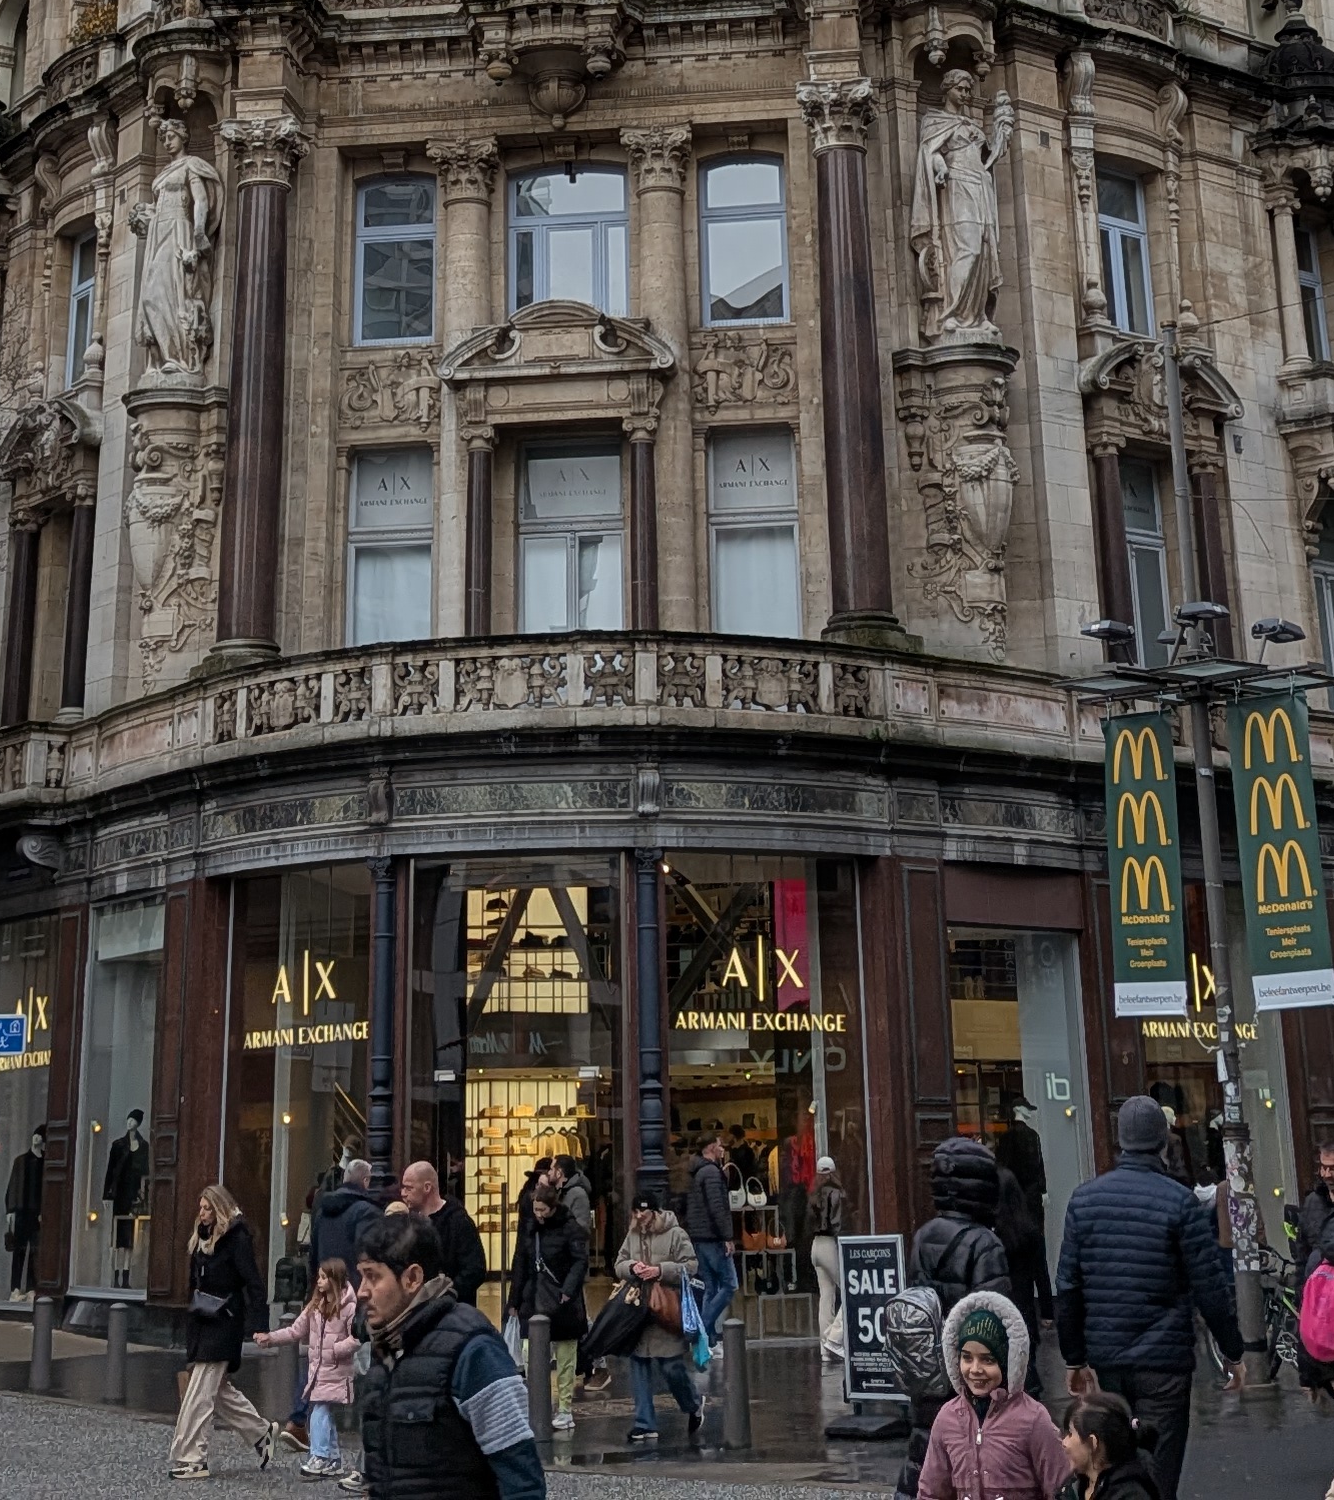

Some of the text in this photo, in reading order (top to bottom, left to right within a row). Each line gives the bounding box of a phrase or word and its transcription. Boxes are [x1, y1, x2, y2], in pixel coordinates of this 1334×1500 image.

[1258, 900, 1313, 915] McDonald's
[1121, 914, 1170, 925] McDonald's
[1265, 925, 1311, 936] Teniersplaats
[1127, 938, 1167, 946] Teniersplaats
[1281, 938, 1297, 946] Meir
[1270, 948, 1312, 959] Groenplaats
[1130, 960, 1167, 968] Groenplaats
[1259, 983, 1332, 998] beleefantwerpen.be
[1119, 994, 1182, 1004] beleefantwerpen.be
[675, 1011, 847, 1032] ARMANI EXCHANGE
[1142, 1020, 1259, 1039] ARMANI EXCNGE
[243, 1021, 369, 1050] ARMANI EXCHANGE
[848, 1268, 897, 1295] SALE
